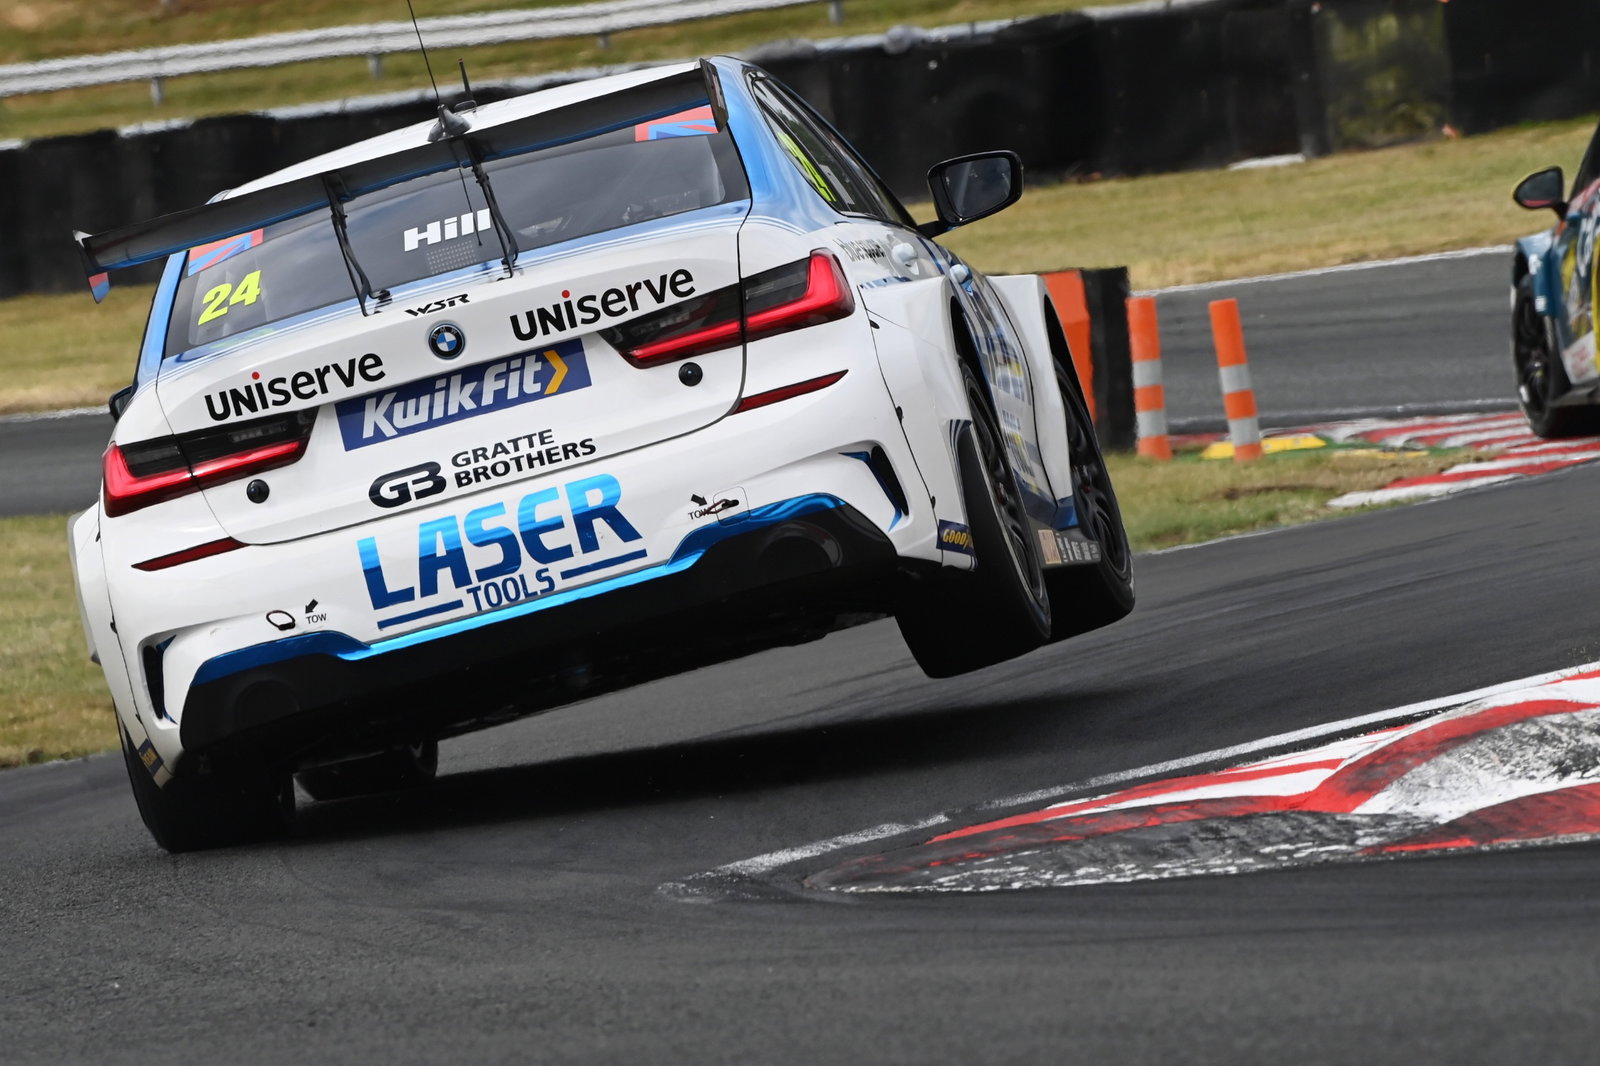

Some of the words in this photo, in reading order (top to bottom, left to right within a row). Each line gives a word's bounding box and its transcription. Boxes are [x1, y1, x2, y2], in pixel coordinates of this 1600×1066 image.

[404, 208, 491, 252] Hill
[198, 270, 261, 325] 24
[405, 293, 470, 316] WSR
[451, 429, 555, 468] GRATTE
[454, 438, 597, 488] BROTHERS
[368, 461, 447, 508] GB
[357, 473, 643, 610] LASER
[466, 567, 555, 612] TOOLS
[306, 613, 327, 624] TOW
